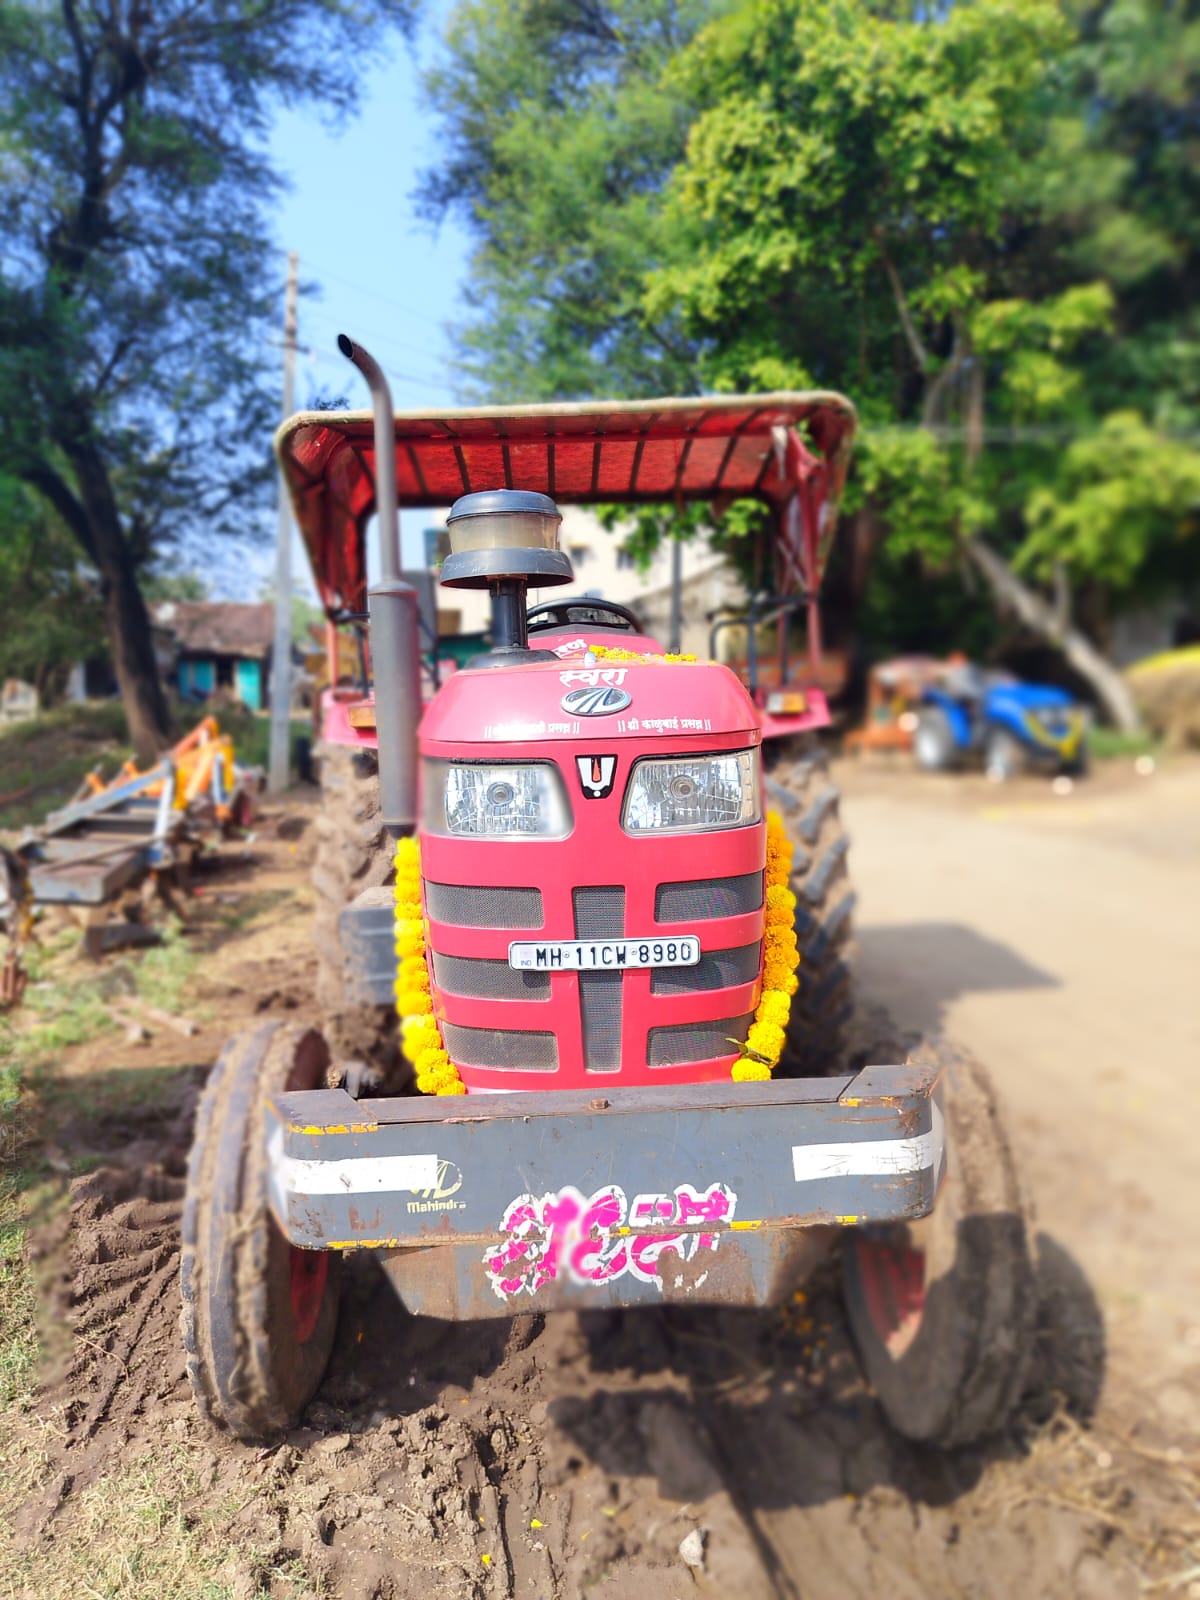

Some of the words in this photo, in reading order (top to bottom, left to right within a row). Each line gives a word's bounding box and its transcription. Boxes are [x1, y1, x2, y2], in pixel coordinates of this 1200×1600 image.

[559, 668, 628, 687] स्वरा
[628, 717, 639, 731] श्री
[535, 947, 563, 967] MH
[575, 945, 627, 966] 11CW
[638, 942, 692, 964] 8980
[406, 1199, 467, 1214] Mahindra
